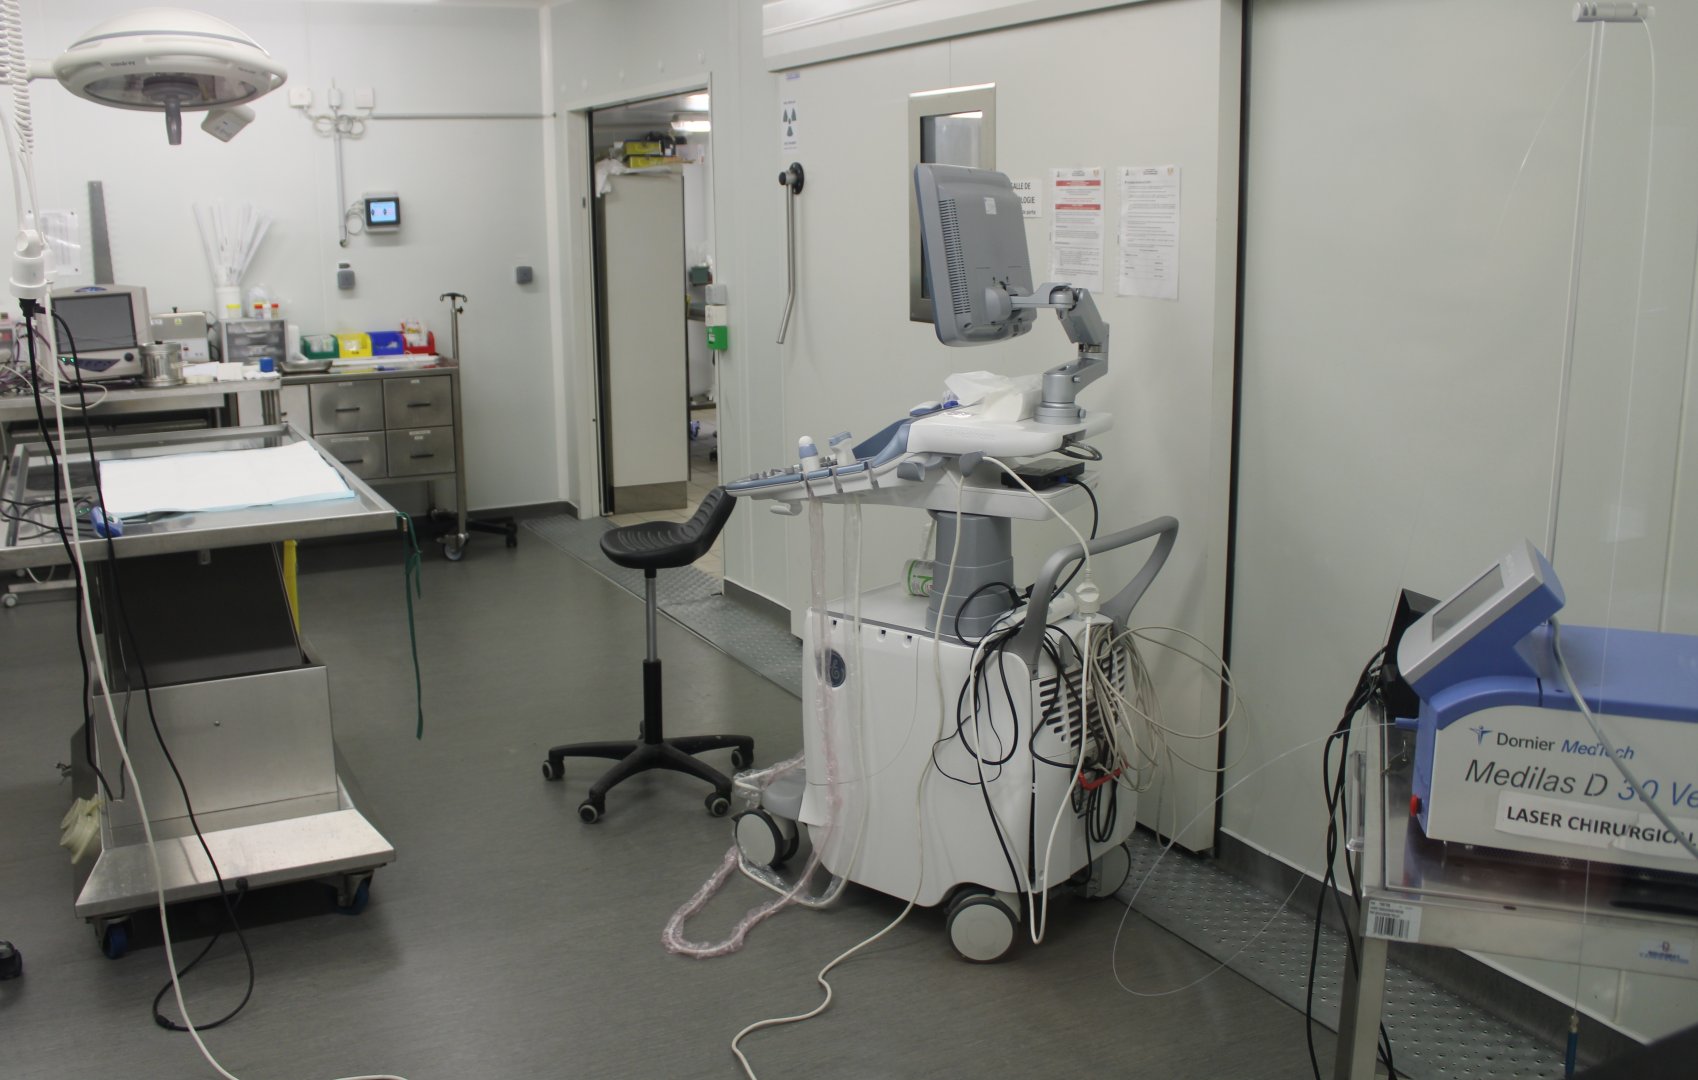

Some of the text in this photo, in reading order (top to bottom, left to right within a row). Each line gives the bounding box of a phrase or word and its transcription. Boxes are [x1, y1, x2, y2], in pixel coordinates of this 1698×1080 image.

[1025, 182, 1031, 190] DE
[1020, 196, 1036, 204] LOGIE
[1496, 732, 1556, 751] Dornier
[1465, 759, 1576, 793] Medilas
[1583, 773, 1608, 797] D
[1617, 778, 1659, 802] 30
[1507, 806, 1562, 828] LASER
